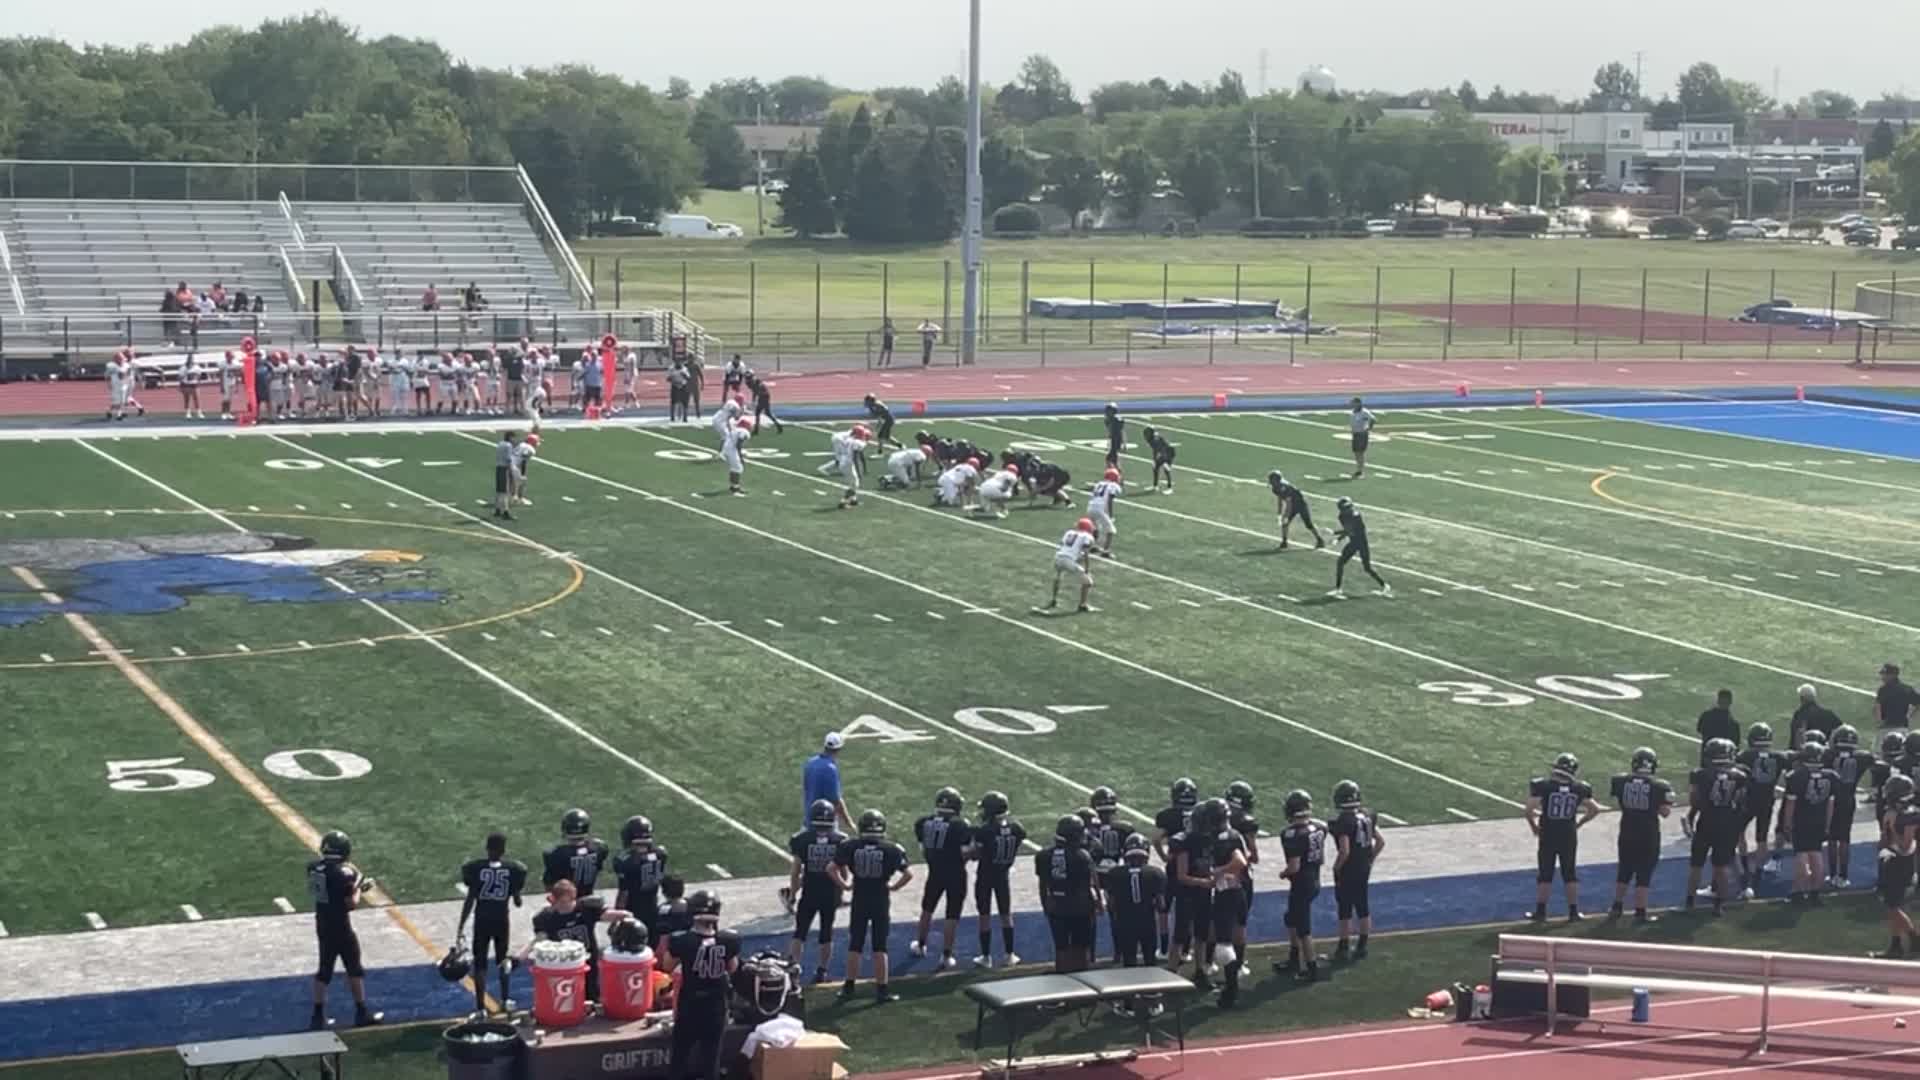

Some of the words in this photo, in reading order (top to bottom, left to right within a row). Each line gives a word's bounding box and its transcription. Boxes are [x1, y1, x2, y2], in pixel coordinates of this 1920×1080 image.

[1418, 674, 1643, 707] 30
[839, 706, 1057, 744] 40
[105, 748, 373, 792] 50
[479, 867, 510, 900] 25
[691, 944, 727, 980] 46
[556, 979, 573, 997] G
[628, 972, 643, 989] G
[602, 1049, 671, 1071] GRIFFIN
